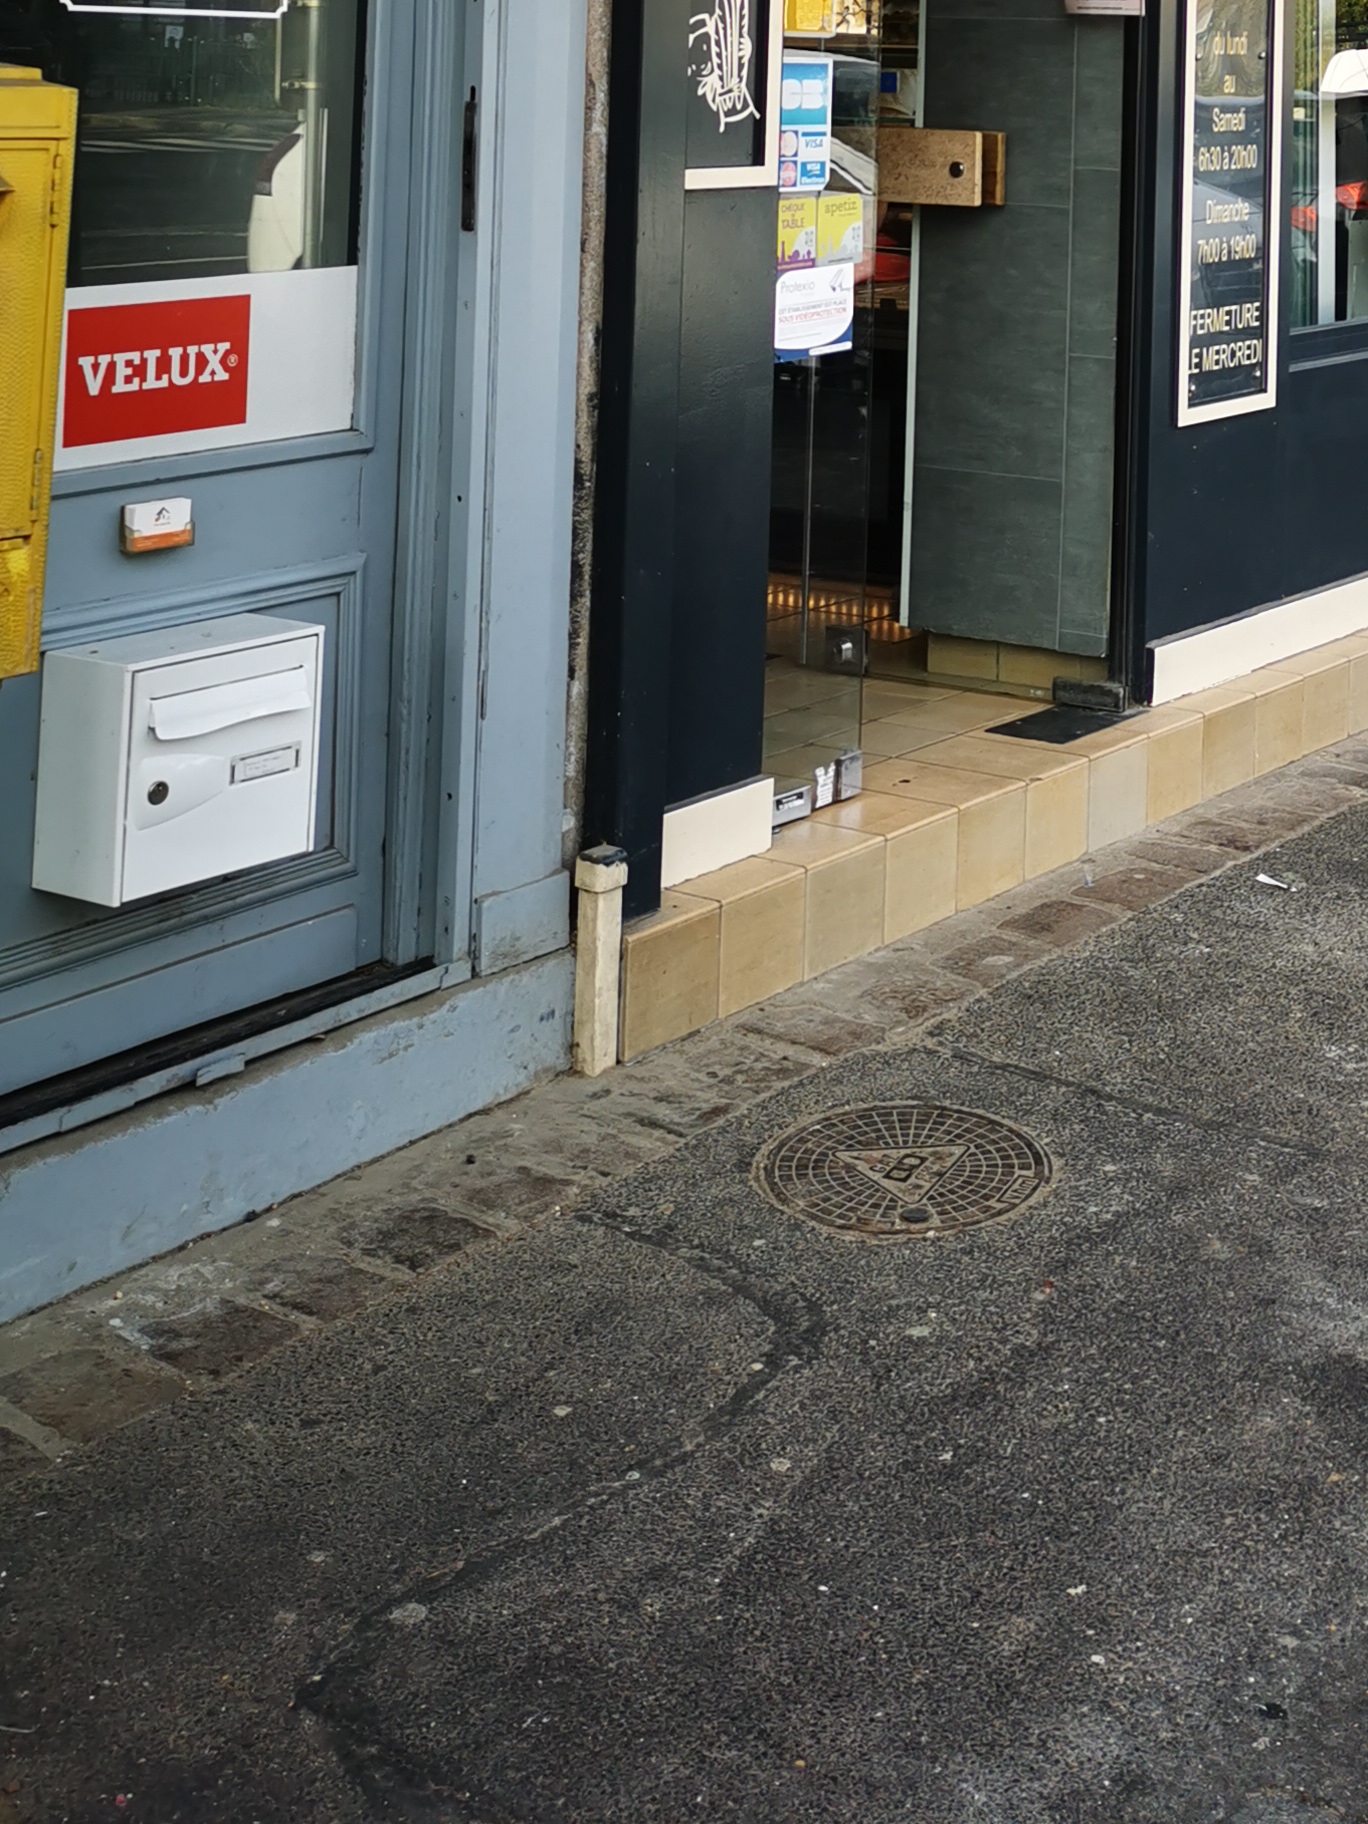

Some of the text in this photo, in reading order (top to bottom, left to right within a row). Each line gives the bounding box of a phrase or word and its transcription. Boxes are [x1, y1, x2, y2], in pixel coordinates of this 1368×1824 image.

[1213, 31, 1248, 55] du lundi
[1223, 75, 1236, 94] au
[1212, 108, 1246, 133] Samedi
[805, 138, 824, 148] VISA
[1198, 144, 1257, 172] 6h30 à 20h00
[824, 198, 857, 216] apetiz
[1205, 197, 1250, 224] Dimanche
[782, 217, 805, 229] TABLE
[1197, 234, 1256, 265] 7h00 à 19h00
[781, 280, 815, 294] Protexio
[1190, 302, 1261, 336] FERMETURE
[1202, 339, 1262, 372] MERCREDI
[77, 340, 231, 397] VELUX
